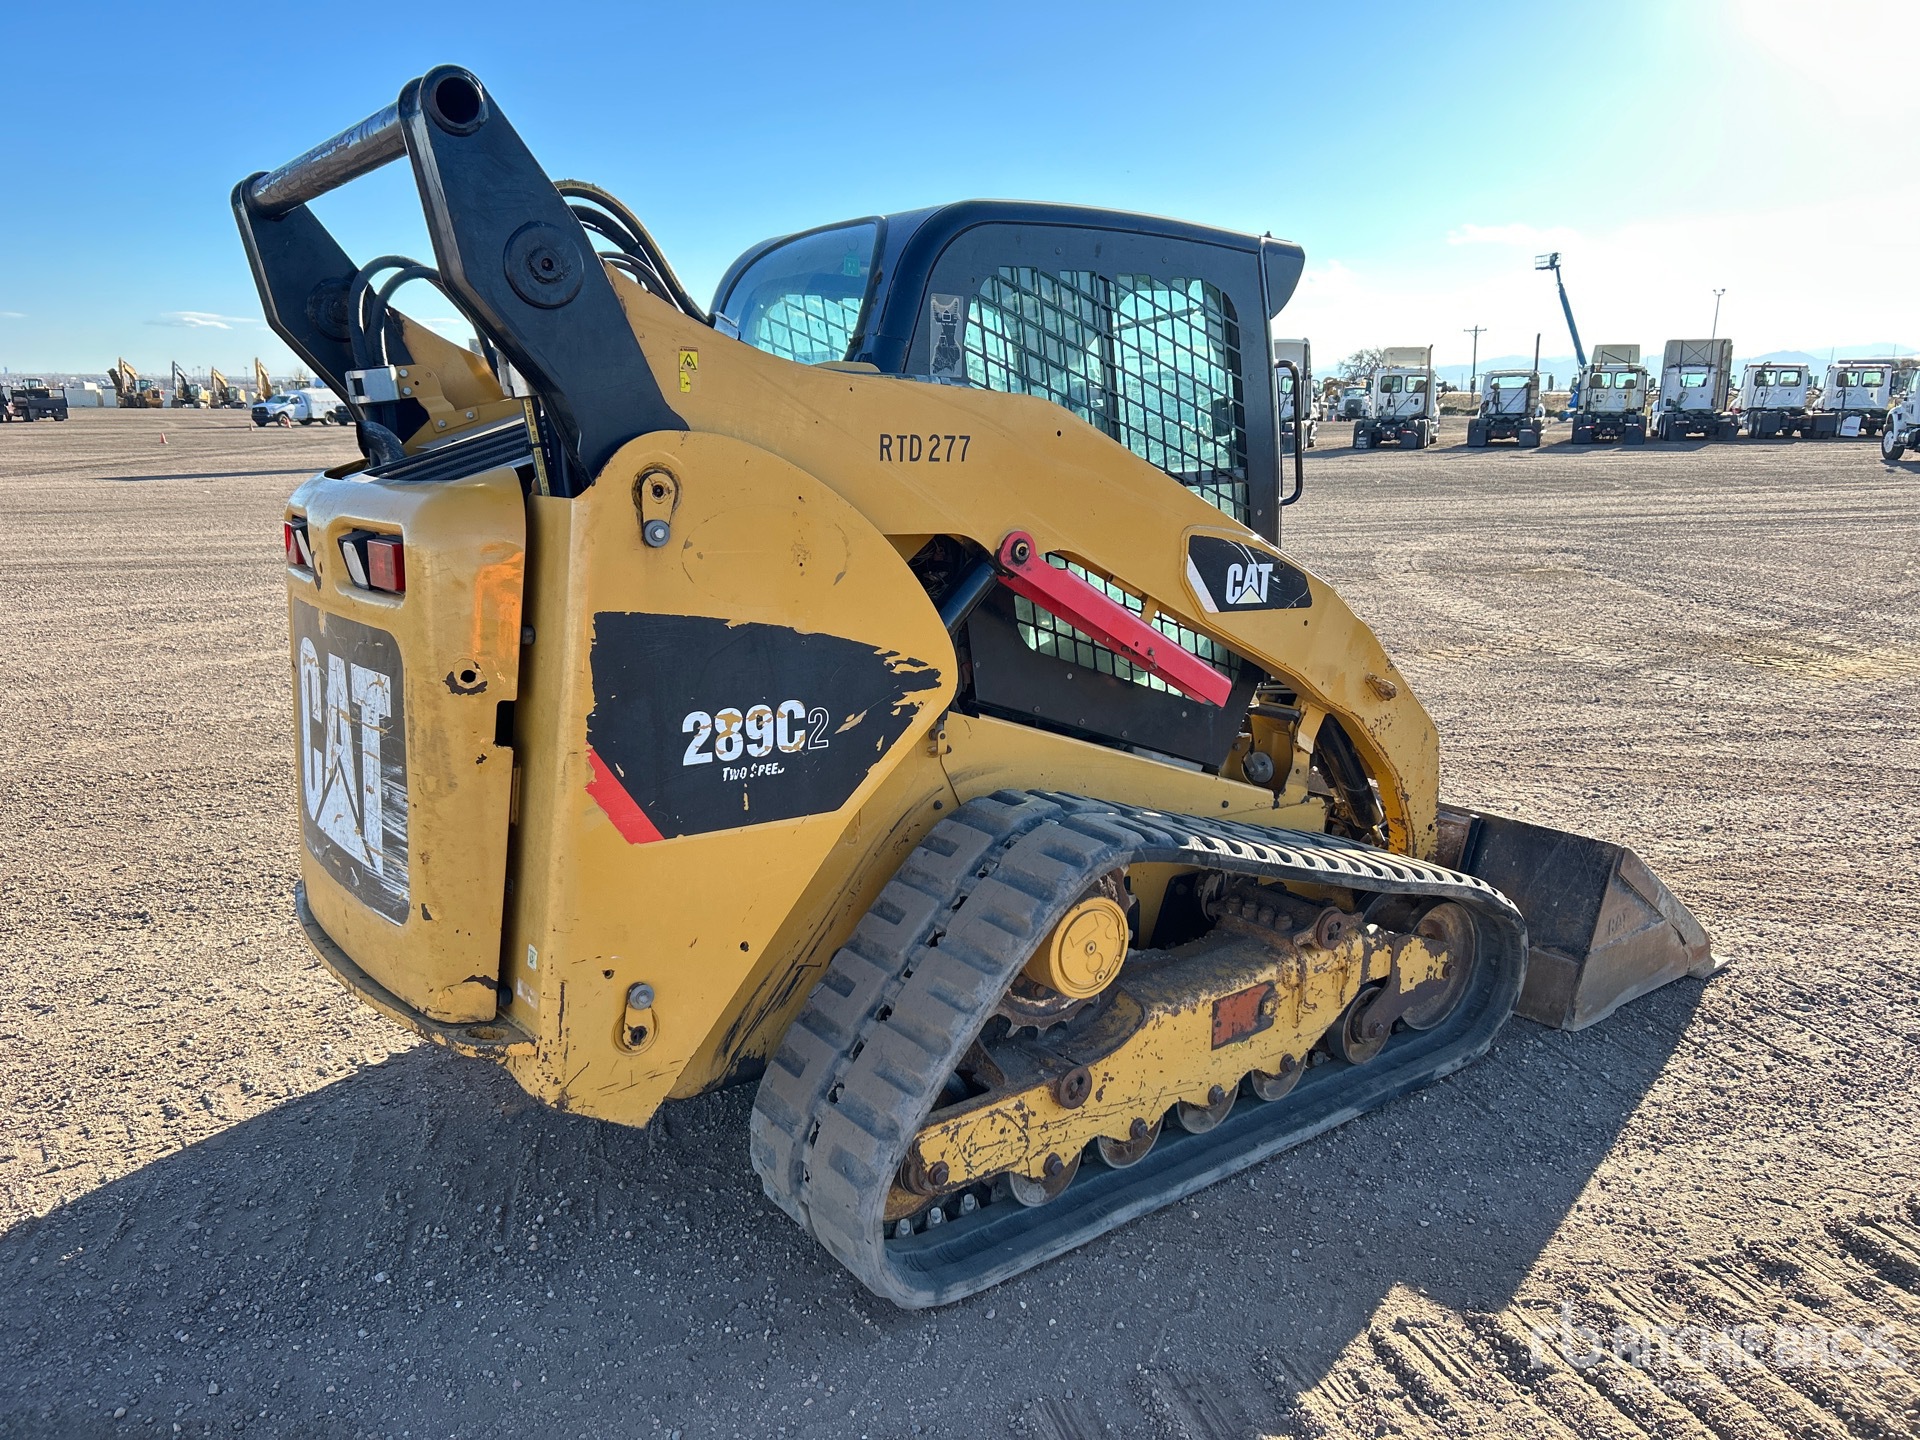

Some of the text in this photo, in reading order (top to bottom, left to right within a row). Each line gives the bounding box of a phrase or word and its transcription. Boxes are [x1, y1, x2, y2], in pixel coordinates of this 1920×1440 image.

[880, 434, 971, 462] RTD 277
[1226, 563, 1273, 605] CAT
[300, 637, 391, 876] CAT
[722, 766, 747, 782] TWO
